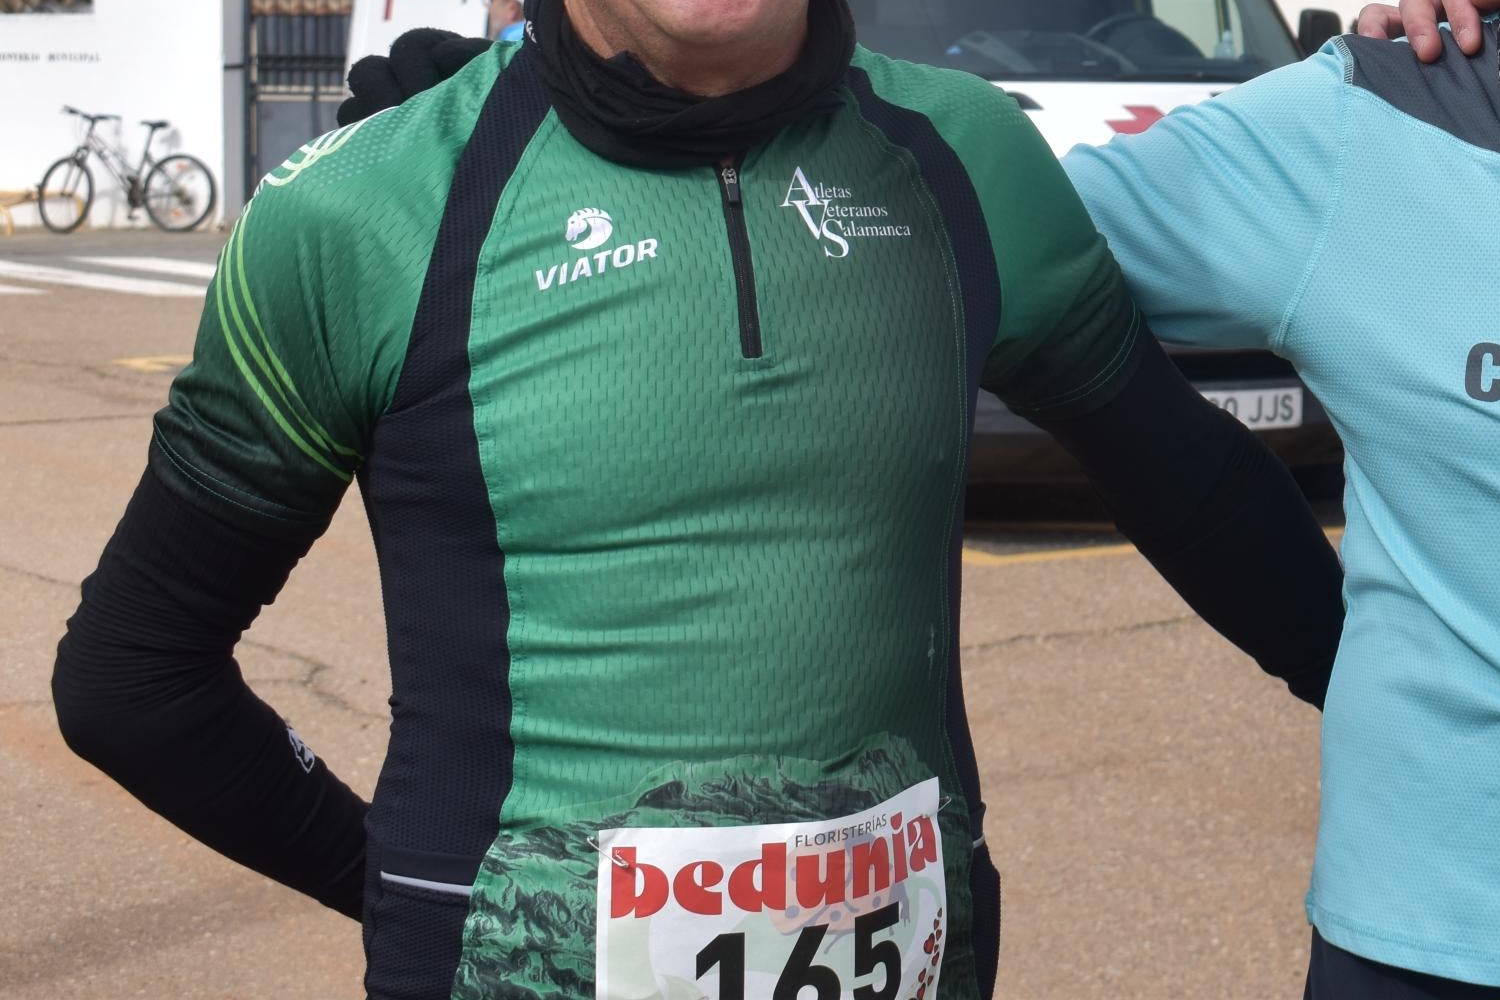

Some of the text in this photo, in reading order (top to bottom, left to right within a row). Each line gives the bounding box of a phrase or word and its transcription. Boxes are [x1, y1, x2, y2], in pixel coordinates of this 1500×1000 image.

[780, 166, 852, 207] Atletas
[789, 199, 888, 240] Veteranos
[822, 219, 912, 258] Salamanca
[535, 238, 658, 291] VIATOR
[1249, 393, 1294, 423] JJS
[795, 813, 888, 848] FLORISTERÍAS
[610, 811, 937, 919] bedunia
[695, 901, 901, 1000] 165
